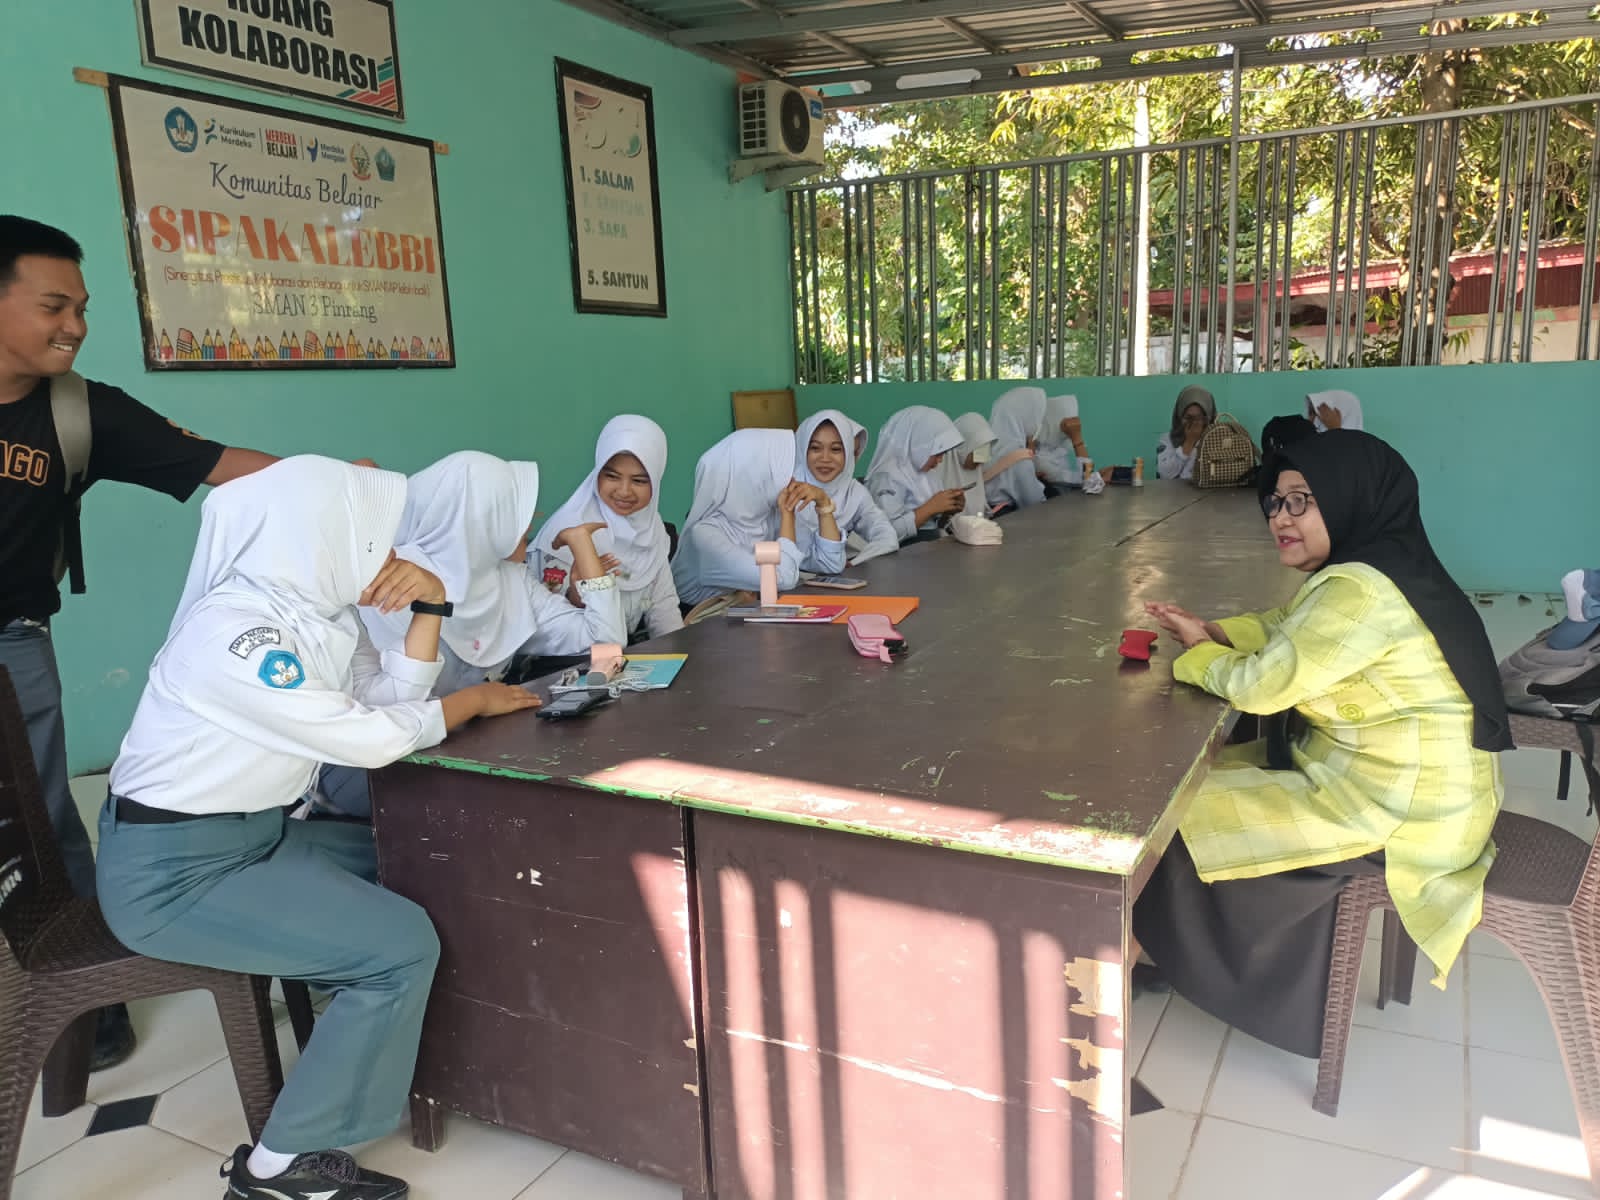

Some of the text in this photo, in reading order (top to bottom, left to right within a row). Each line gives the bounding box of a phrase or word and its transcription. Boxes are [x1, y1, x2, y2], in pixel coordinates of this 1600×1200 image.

[178, 6, 380, 92] KOLABORASI
[219, 125, 256, 138] Kurikulum
[265, 129, 297, 146] MERDEKA
[266, 144, 298, 160] BELAJAR
[209, 161, 382, 220] Komunitas Belajar
[580, 166, 634, 192] 1. SALAM
[149, 205, 436, 274] SIPAKALEBBI
[587, 269, 648, 290] 5. SANTUN
[254, 292, 305, 317] SMAN
[310, 295, 320, 317] 3
